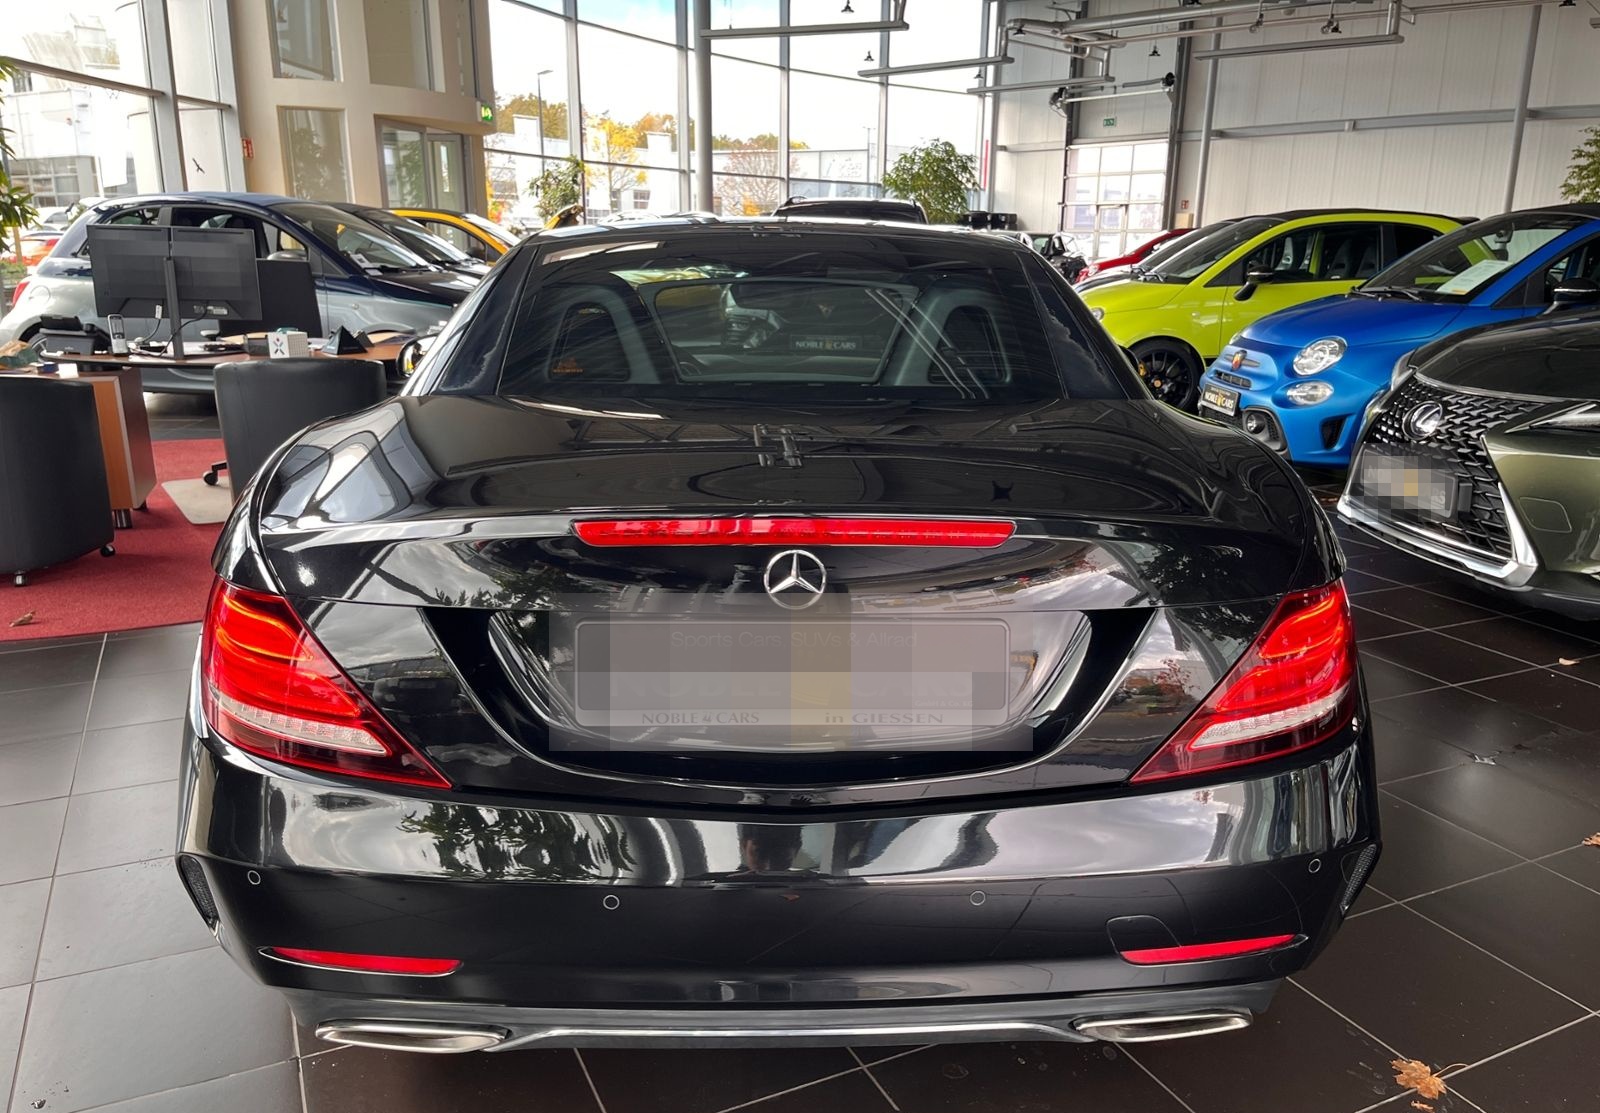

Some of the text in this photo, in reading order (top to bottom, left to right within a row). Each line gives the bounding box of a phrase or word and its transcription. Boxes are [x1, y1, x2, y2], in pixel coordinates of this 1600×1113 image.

[671, 631, 733, 650] Sports
[791, 631, 841, 647] SUVs
[847, 631, 861, 647] &
[865, 631, 918, 647] Allrad
[641, 712, 760, 724] NOBLE CARS
[825, 712, 943, 724] in GIESSEN
